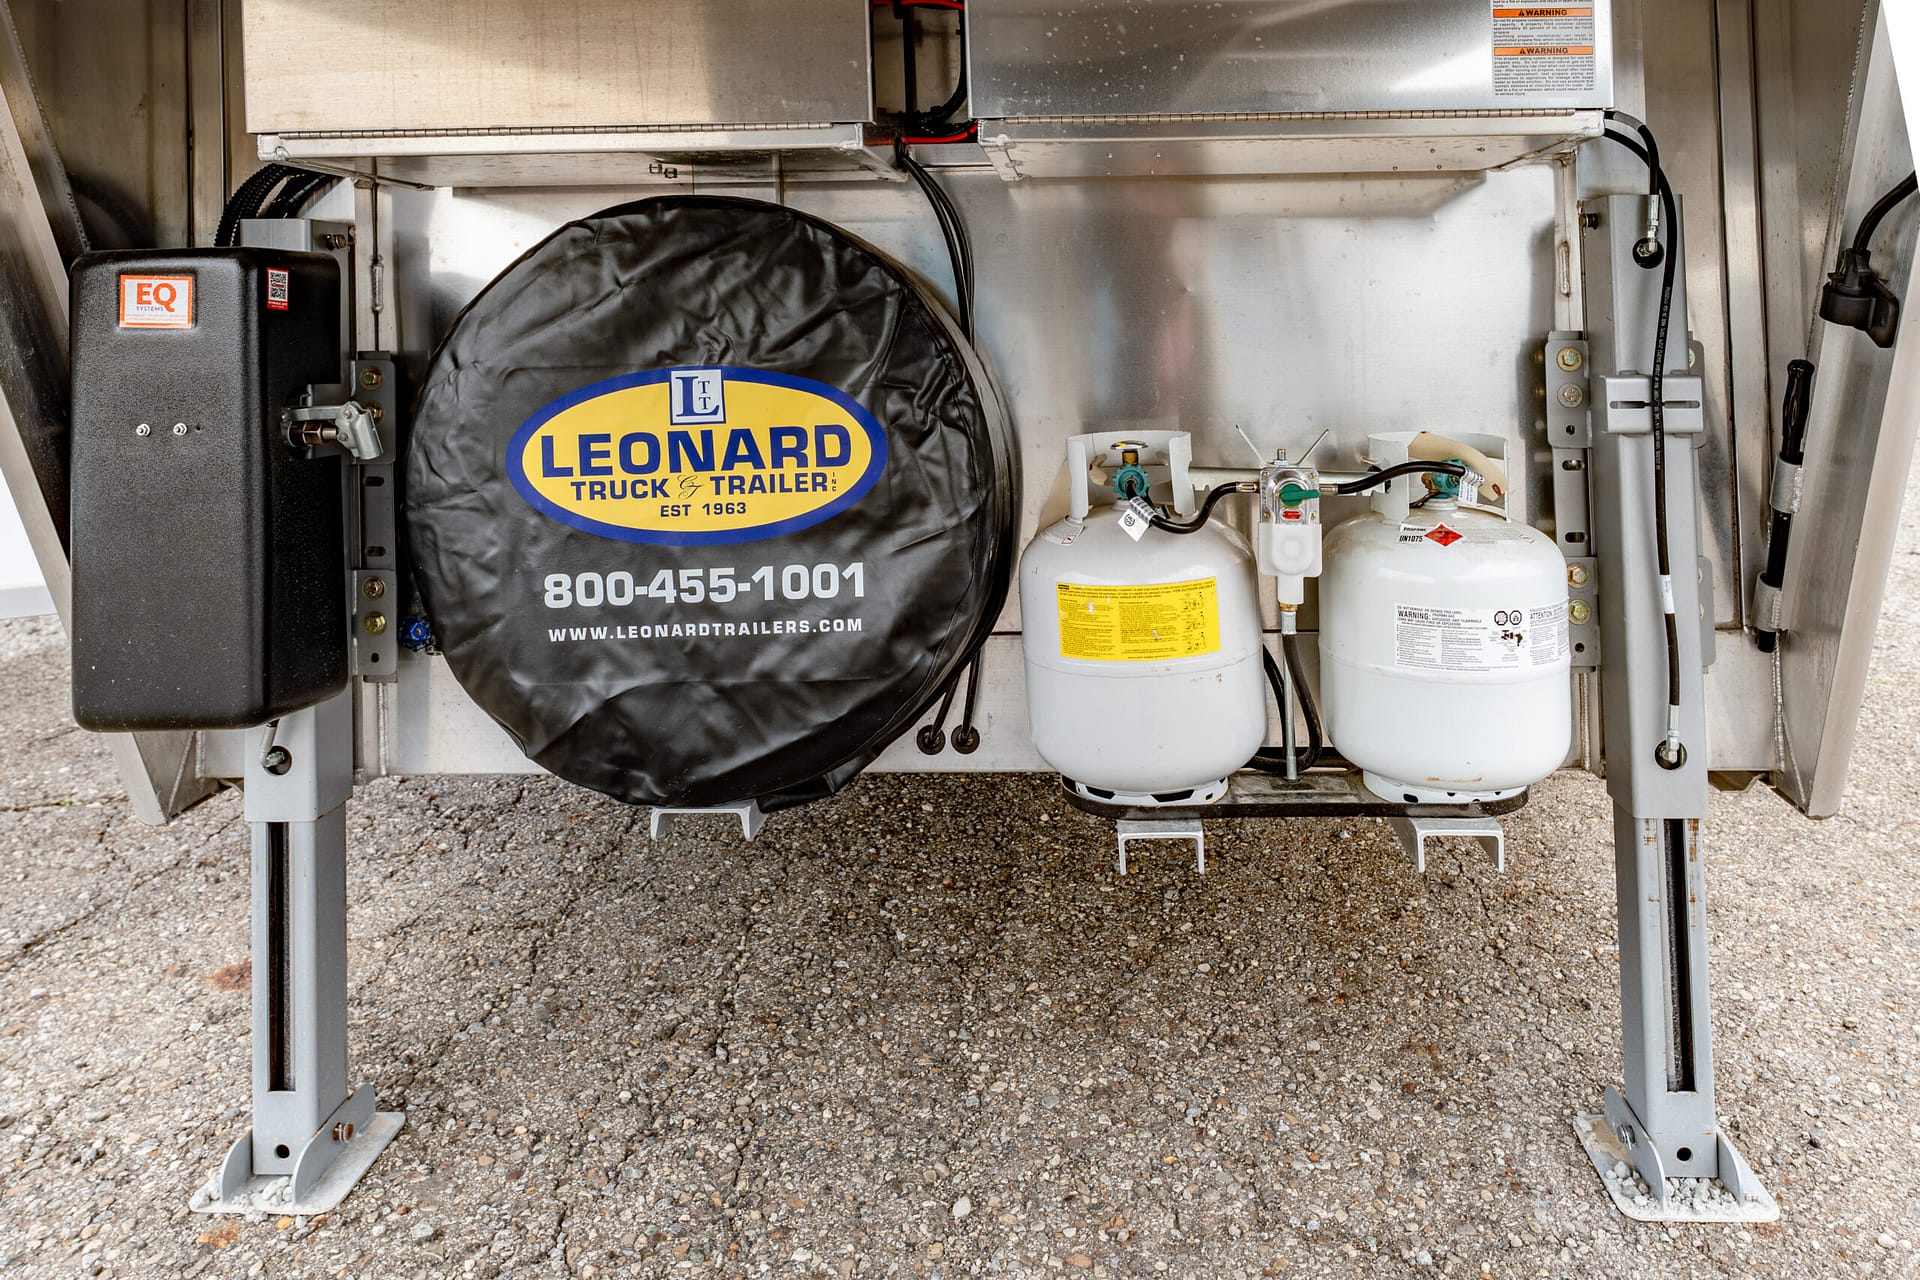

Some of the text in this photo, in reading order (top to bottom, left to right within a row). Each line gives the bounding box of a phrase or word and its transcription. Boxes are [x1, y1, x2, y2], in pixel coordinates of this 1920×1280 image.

[136, 283, 177, 312] EQ
[541, 424, 851, 478] LEONARD
[570, 479, 670, 501] TRUCK
[710, 472, 828, 496] TRAILER
[660, 502, 747, 518] EST 1963
[1399, 535, 1423, 543] UN1075
[544, 562, 865, 609] 800-455-1001
[548, 618, 863, 642] WWW.LEONARDTRAILERS.COM
